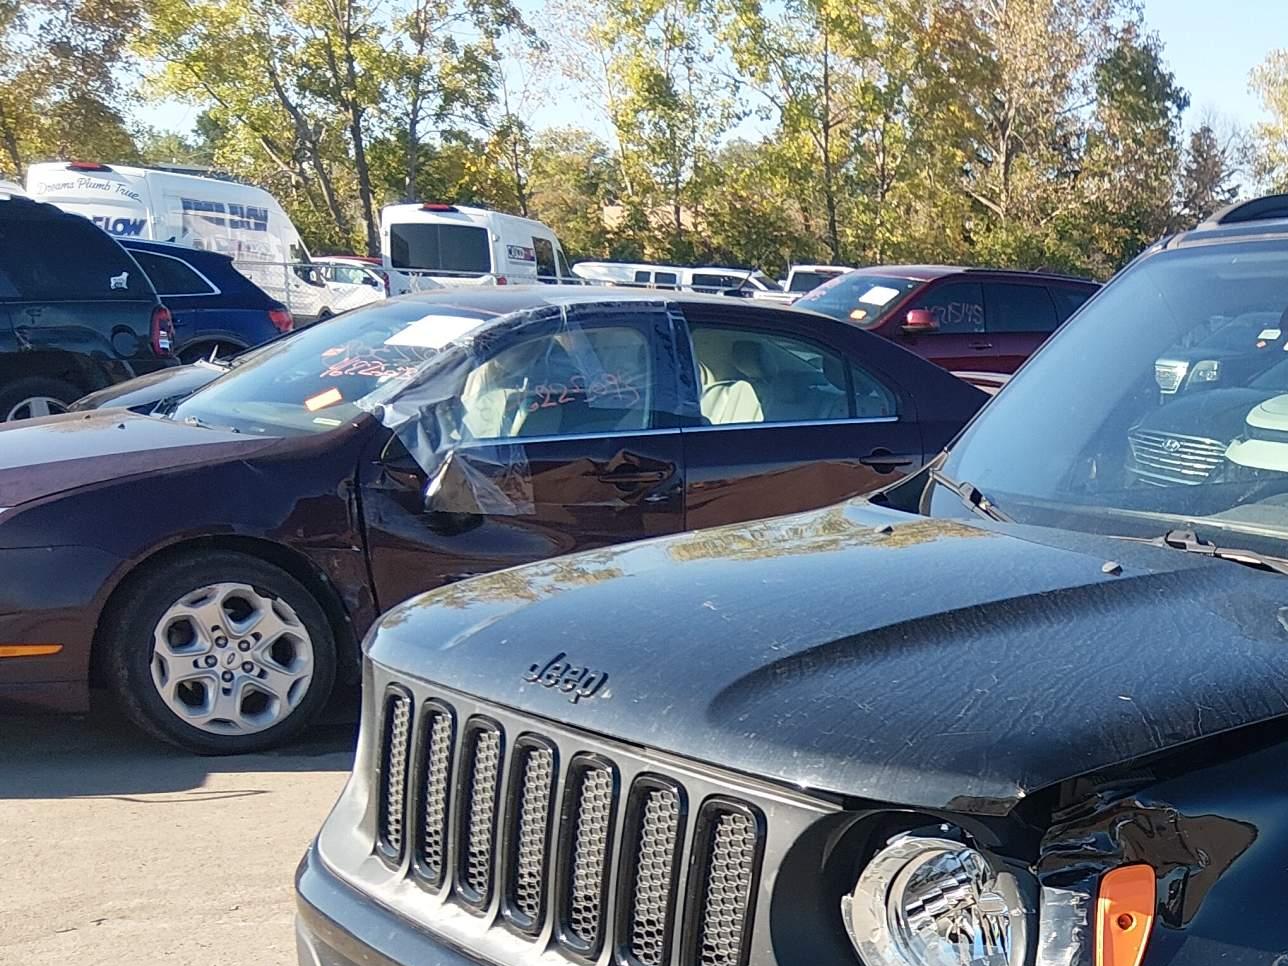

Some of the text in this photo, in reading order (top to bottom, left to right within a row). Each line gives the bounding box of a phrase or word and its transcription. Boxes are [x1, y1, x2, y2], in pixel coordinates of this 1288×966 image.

[77, 177, 112, 191] Plumb
[115, 183, 143, 203] True
[522, 652, 608, 704] Jeep
